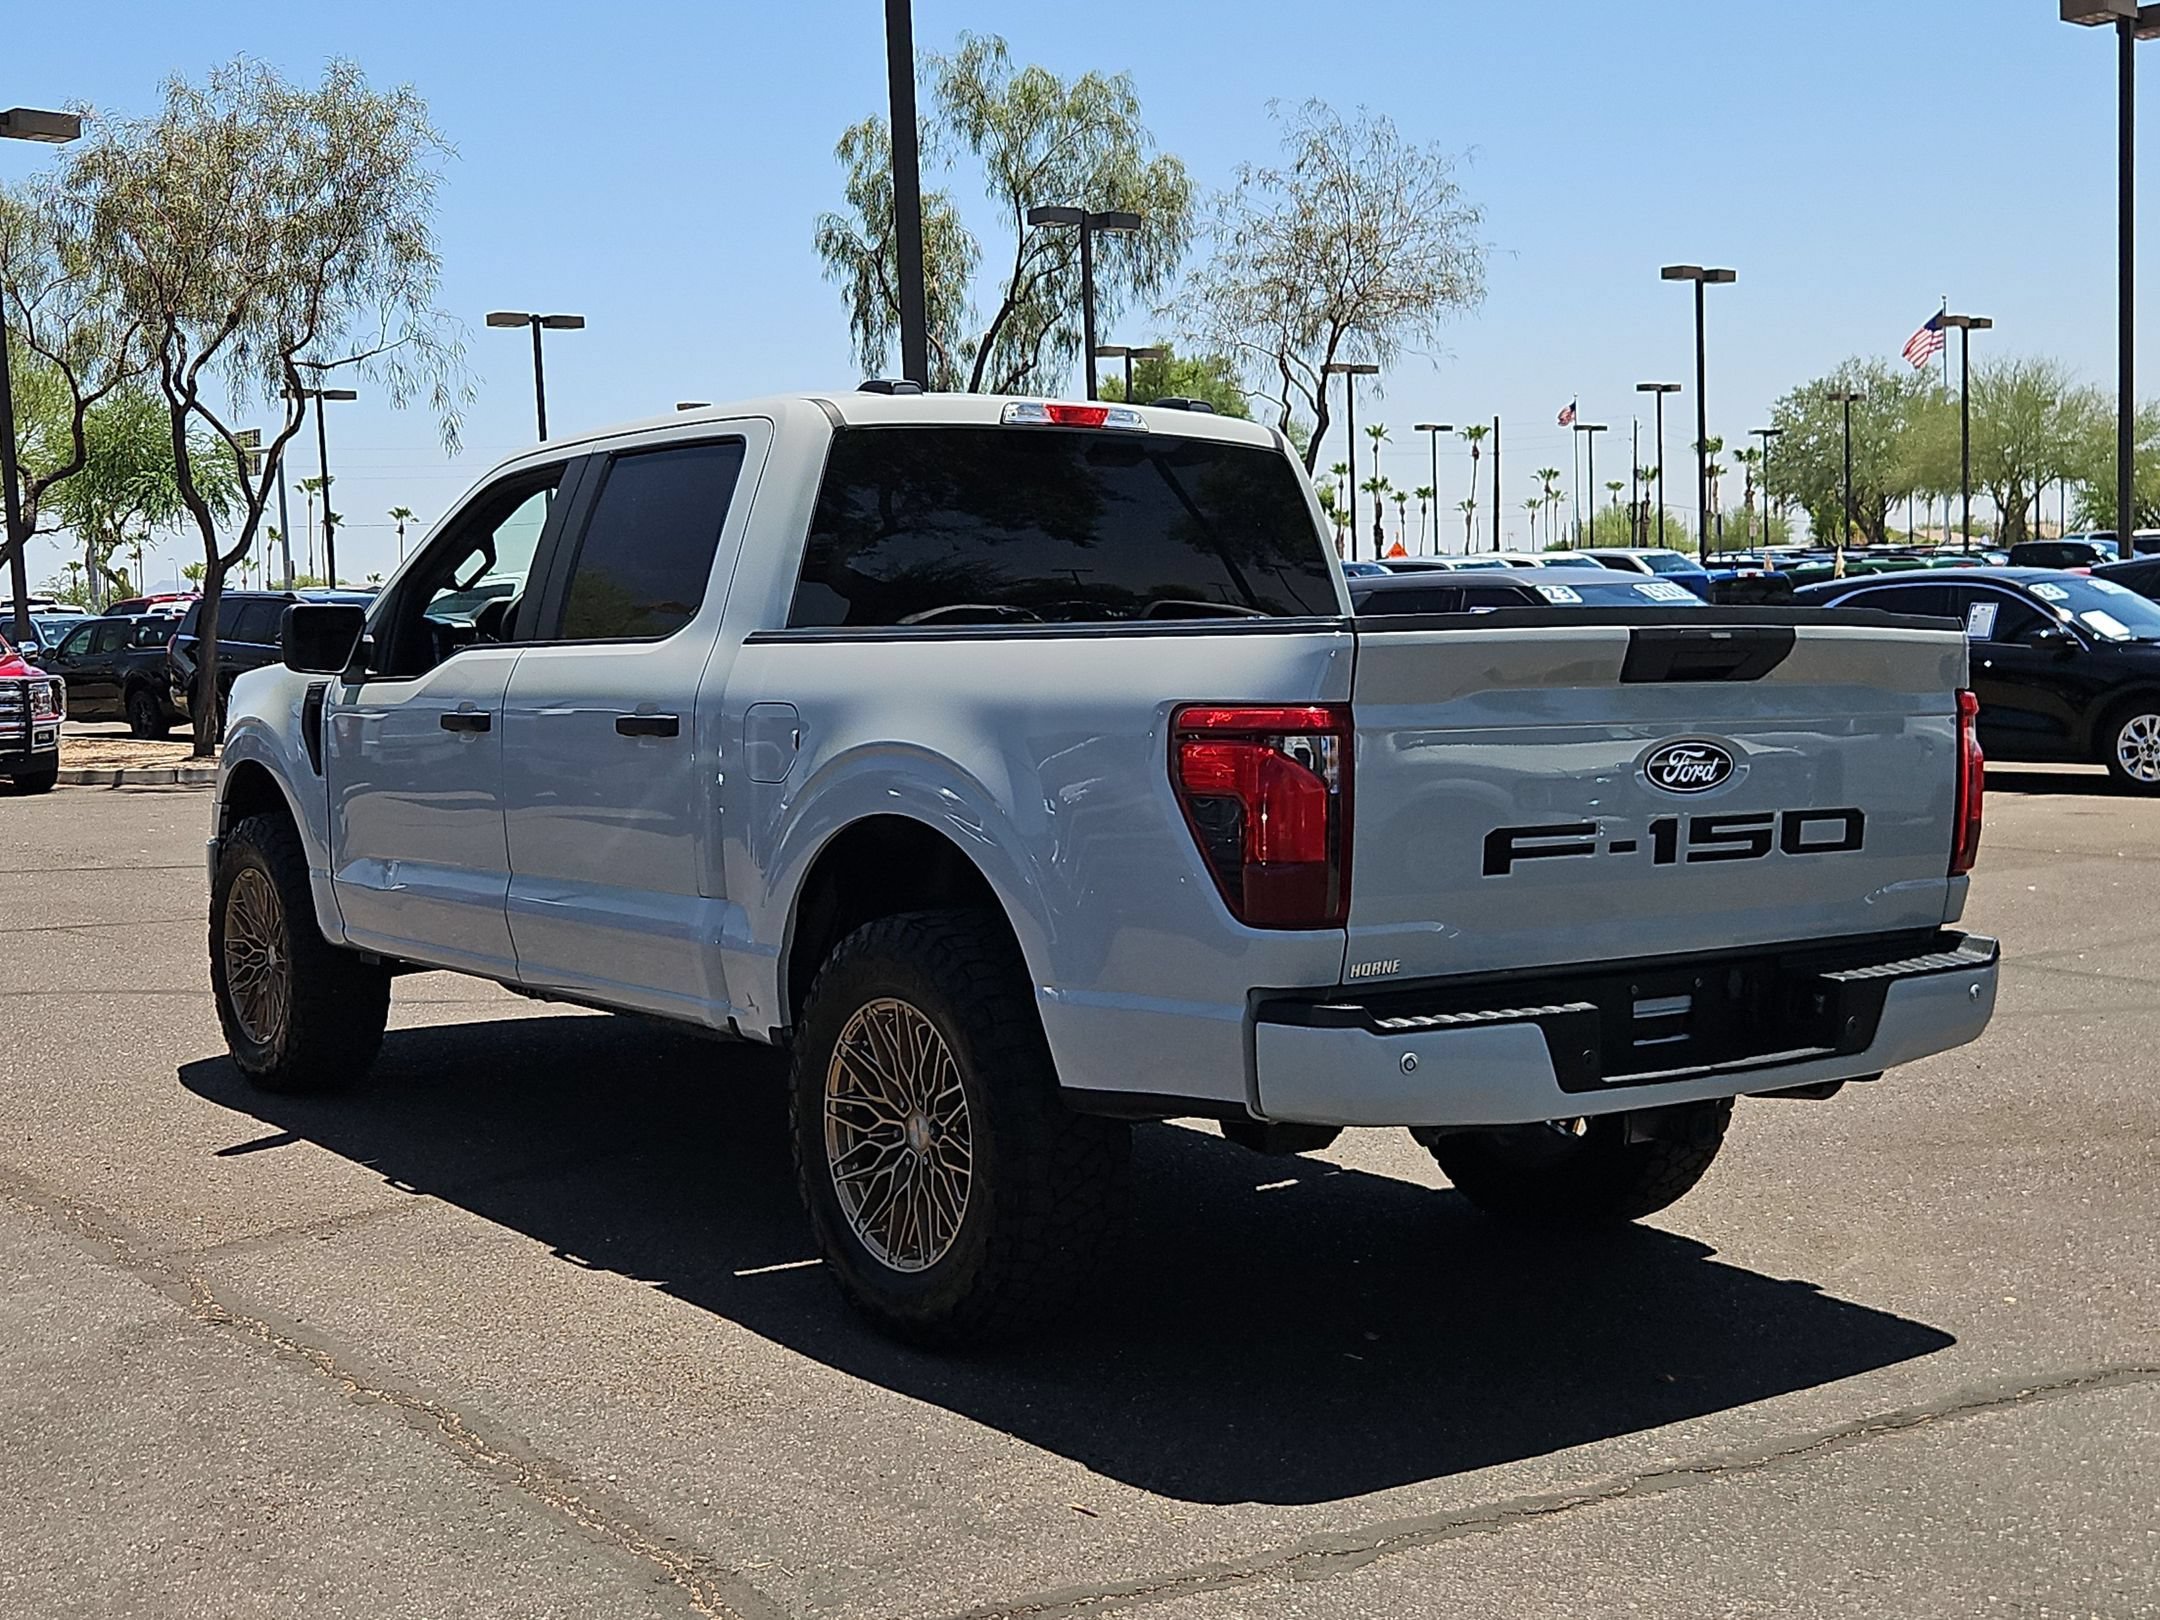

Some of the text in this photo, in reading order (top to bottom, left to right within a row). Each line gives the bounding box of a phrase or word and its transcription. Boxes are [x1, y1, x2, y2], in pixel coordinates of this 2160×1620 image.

[1541, 587, 1574, 600] 23
[1663, 750, 1719, 783] Ford
[1482, 806, 1865, 877] F-150
[1350, 959, 1401, 978] HORNE
